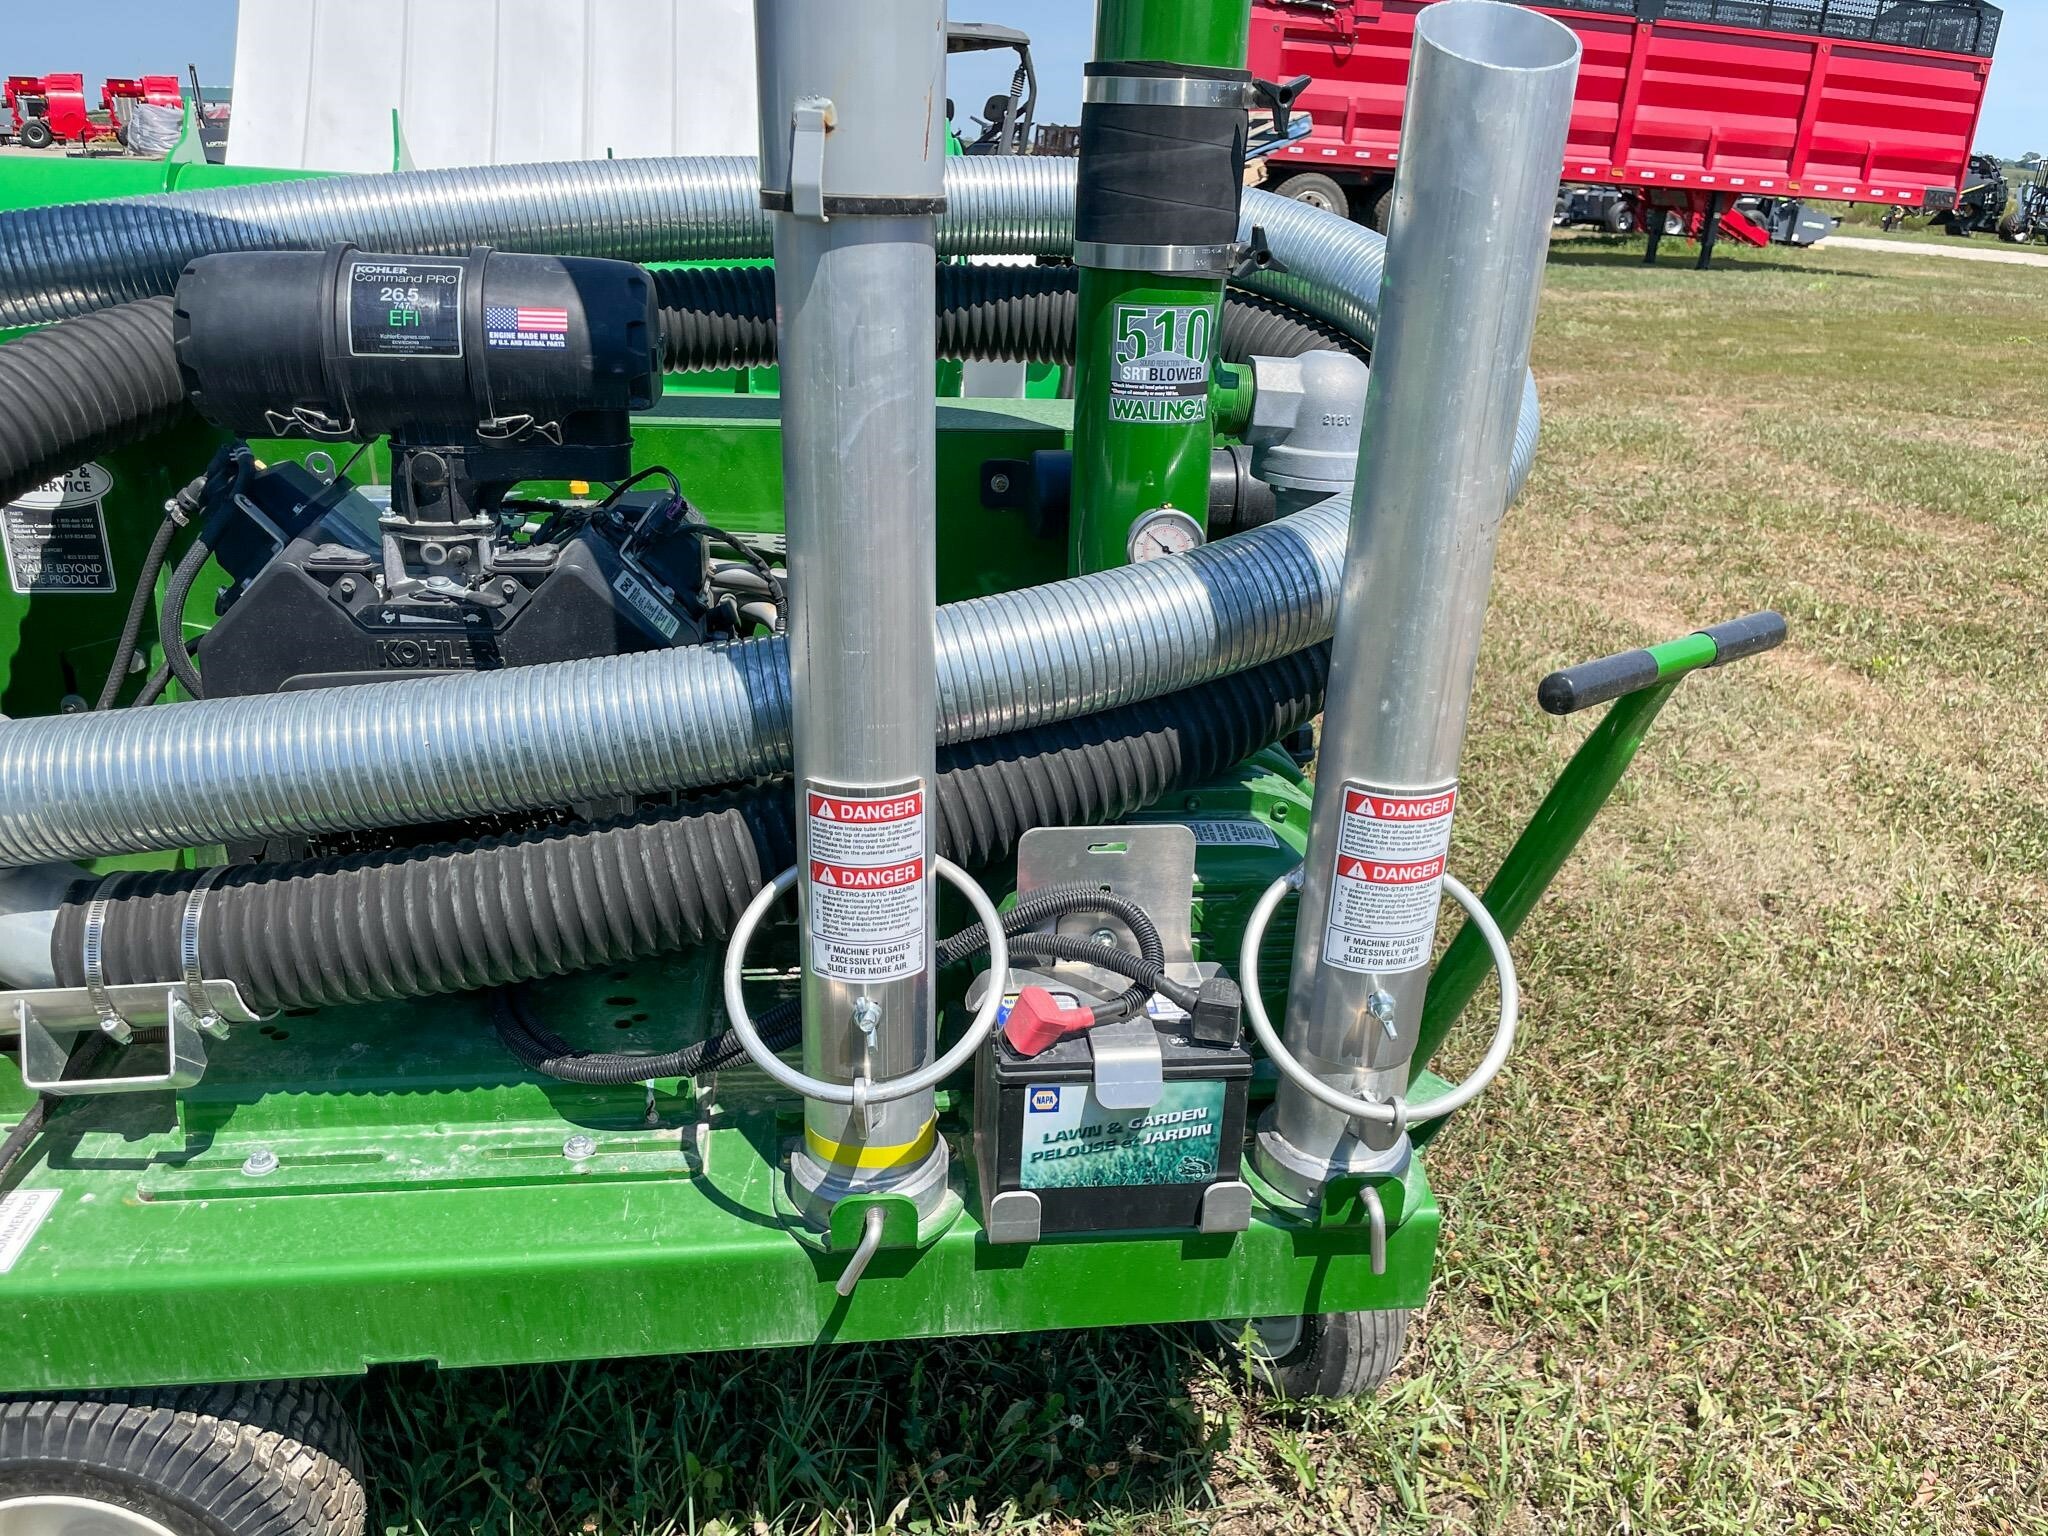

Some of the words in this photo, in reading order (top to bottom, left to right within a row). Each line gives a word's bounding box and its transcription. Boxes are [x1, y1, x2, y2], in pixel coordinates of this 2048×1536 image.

[356, 266, 407, 274] KOHLER
[355, 273, 422, 283] Command
[427, 275, 456, 284] PRO
[380, 288, 418, 302] 26.5
[389, 310, 418, 326] EFI
[1116, 307, 1210, 366] 510
[1111, 398, 1206, 421] WALINGA
[1322, 414, 1351, 427] 2120
[79, 467, 91, 478] &
[20, 564, 53, 573] VALUE
[56, 564, 102, 573] BEYOND
[26, 575, 50, 584] THE
[53, 575, 99, 584] PRODUCT
[841, 799, 916, 820] DANGER
[1382, 798, 1450, 817] DANGER
[842, 865, 915, 886] DANGER
[1373, 862, 1440, 881] DANGER
[828, 888, 887, 898] ELECTRO-STATIC
[889, 885, 915, 896] HAZARD
[1356, 882, 1414, 892] ELECTRO-STATIC
[1353, 937, 1390, 948] MACHINE
[1392, 934, 1425, 947] PULSATES
[833, 944, 870, 956] MACHINE
[872, 942, 910, 956] PULSATES
[1349, 946, 1400, 957] EXCESSIVELY,
[1402, 945, 1419, 956] OPEN
[831, 954, 882, 966] EXCESSIVELY,
[884, 954, 905, 964] OPEN
[1344, 954, 1365, 965] SLIDE
[1368, 957, 1383, 966] FOR
[1386, 956, 1406, 966] MORE
[827, 963, 847, 974] SLIDE
[850, 966, 866, 975] FOR
[868, 964, 892, 975] MORE
[1036, 1096, 1054, 1105] NAPA
[1043, 1124, 1102, 1145] LAWN
[1106, 1122, 1123, 1134] &
[1128, 1106, 1208, 1132] GARDEN
[1030, 1138, 1117, 1164] PELOUSE
[1121, 1135, 1140, 1149] et
[1142, 1123, 1212, 1146] JARDIN
